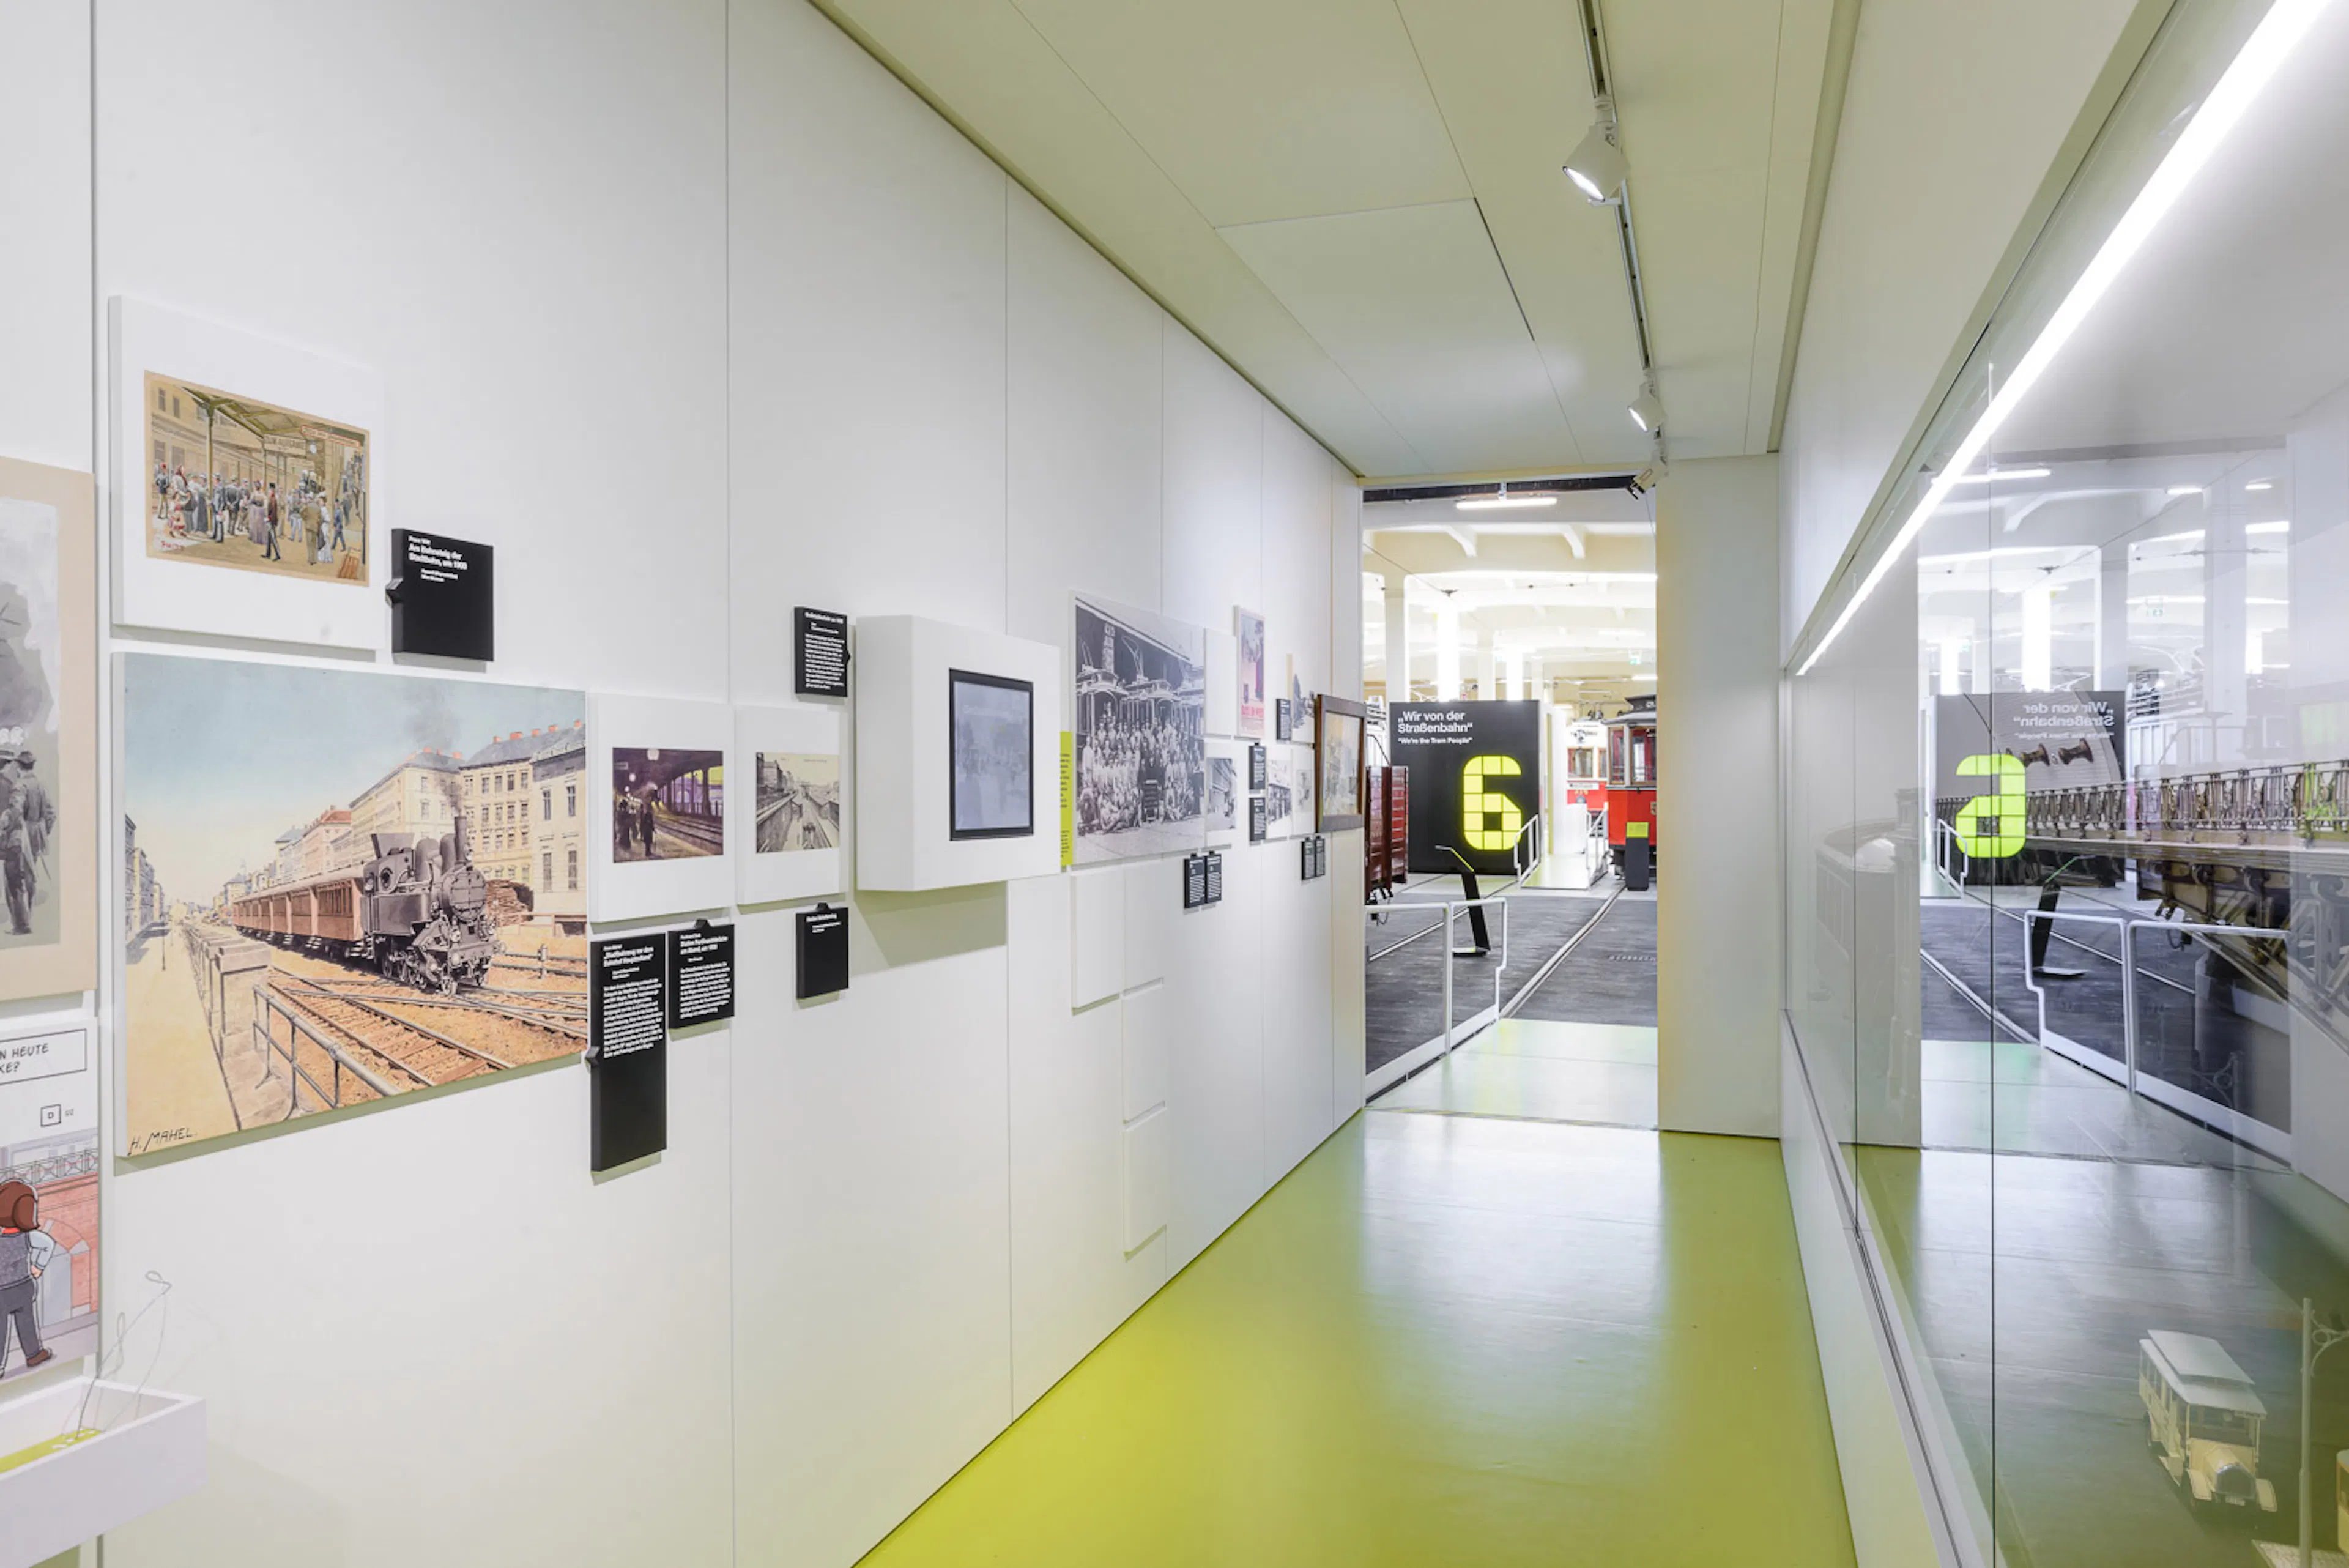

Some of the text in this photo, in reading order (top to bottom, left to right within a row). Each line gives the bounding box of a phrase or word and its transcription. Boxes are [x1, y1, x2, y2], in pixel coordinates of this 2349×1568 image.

[1423, 712, 1444, 721] von
[1446, 710, 1466, 721] der
[1463, 755, 1522, 850] 6
[12, 1042, 49, 1058] HEUTE
